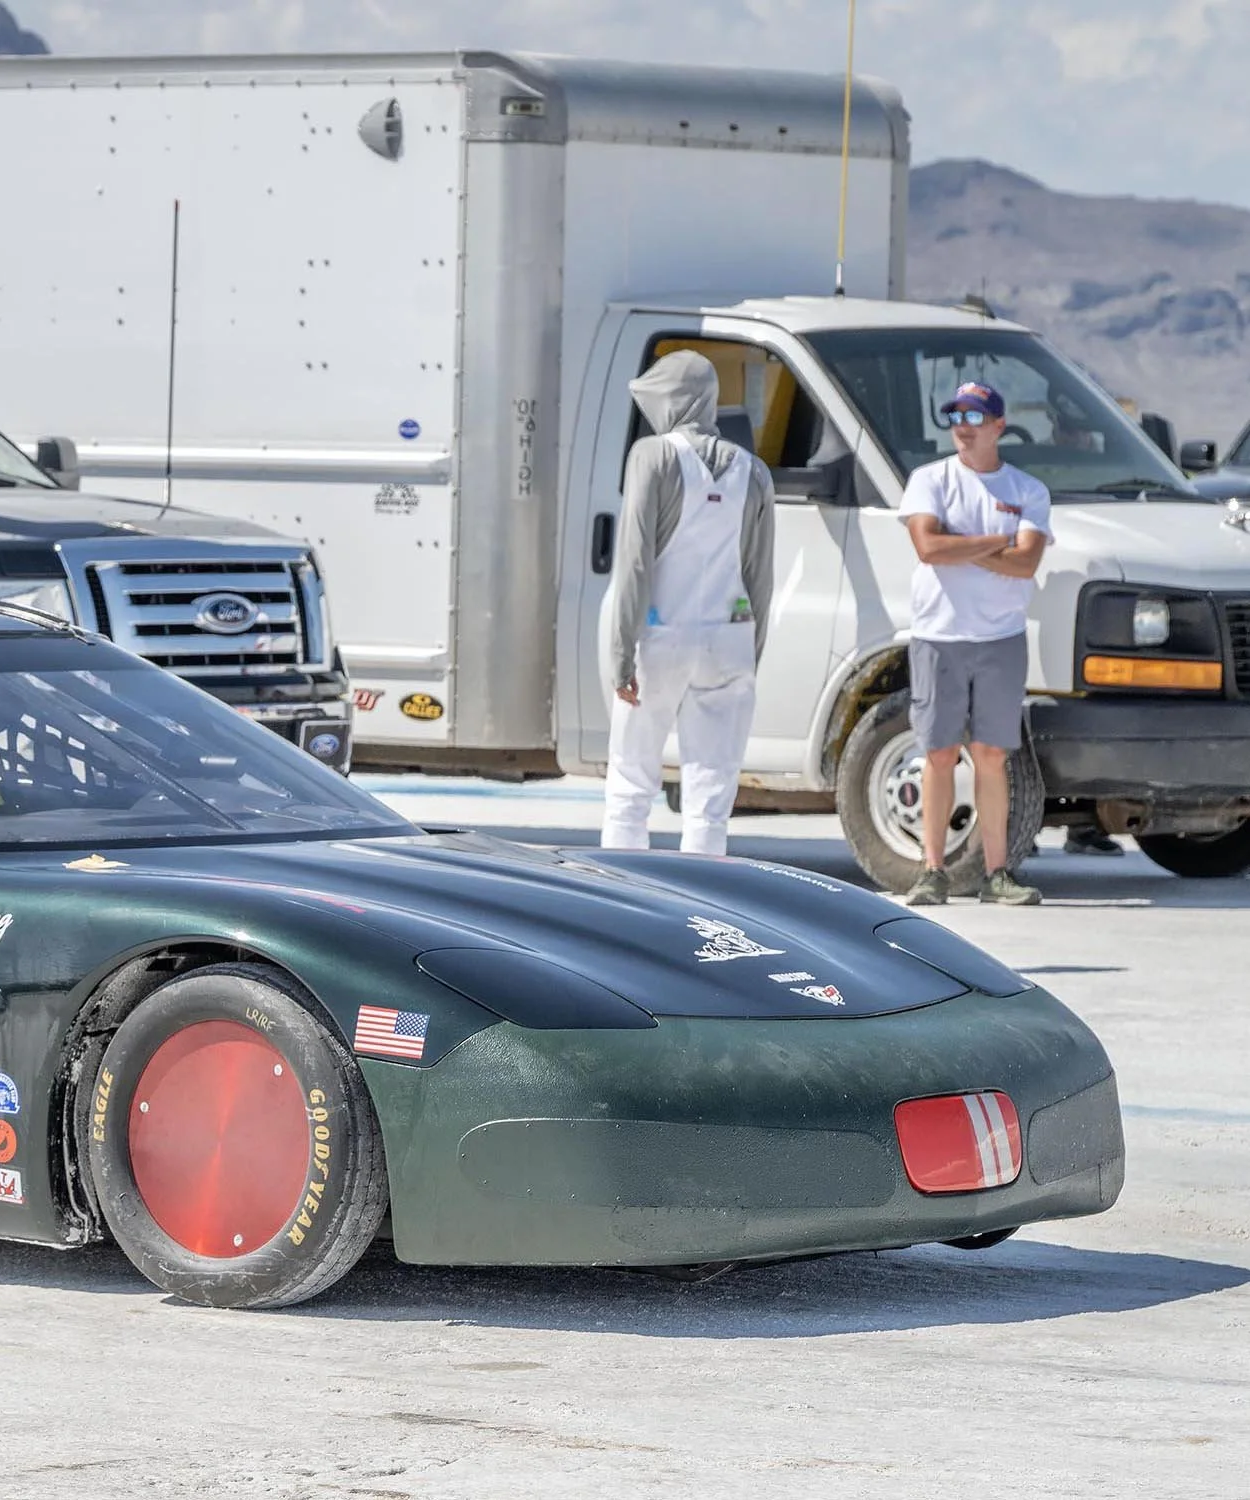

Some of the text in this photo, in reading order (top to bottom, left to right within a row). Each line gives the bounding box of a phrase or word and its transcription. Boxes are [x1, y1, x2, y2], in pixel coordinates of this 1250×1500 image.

[217, 604, 245, 620] Ford
[93, 1067, 115, 1142] EAGLE
[286, 1088, 331, 1247] GOODYEAR
